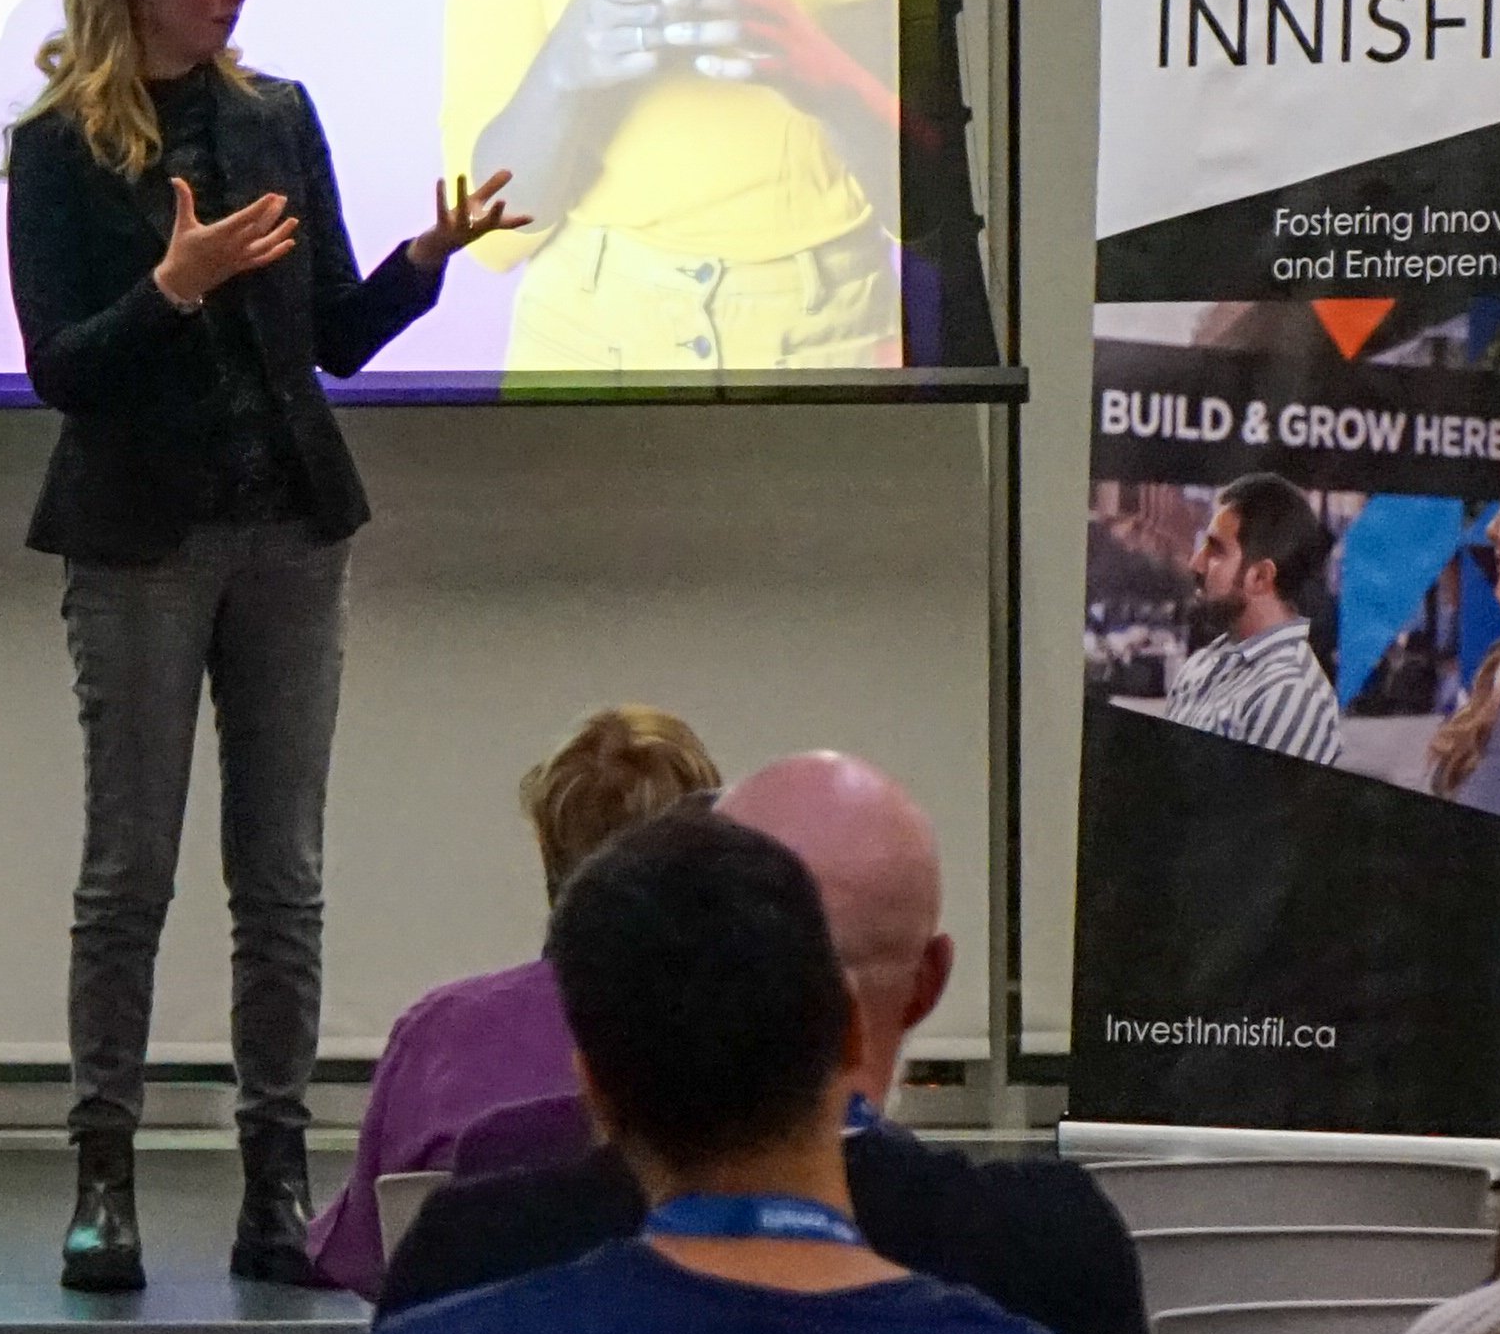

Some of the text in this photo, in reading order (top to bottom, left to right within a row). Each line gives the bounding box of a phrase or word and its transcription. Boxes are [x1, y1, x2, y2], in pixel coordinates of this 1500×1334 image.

[1274, 205, 1413, 241] Fostering
[1273, 249, 1334, 280] and
[1102, 389, 1232, 440] BUILD
[1246, 399, 1269, 445] &
[1279, 407, 1406, 453] GROW
[1107, 1015, 1336, 1048] InvestInnisfil.ca
